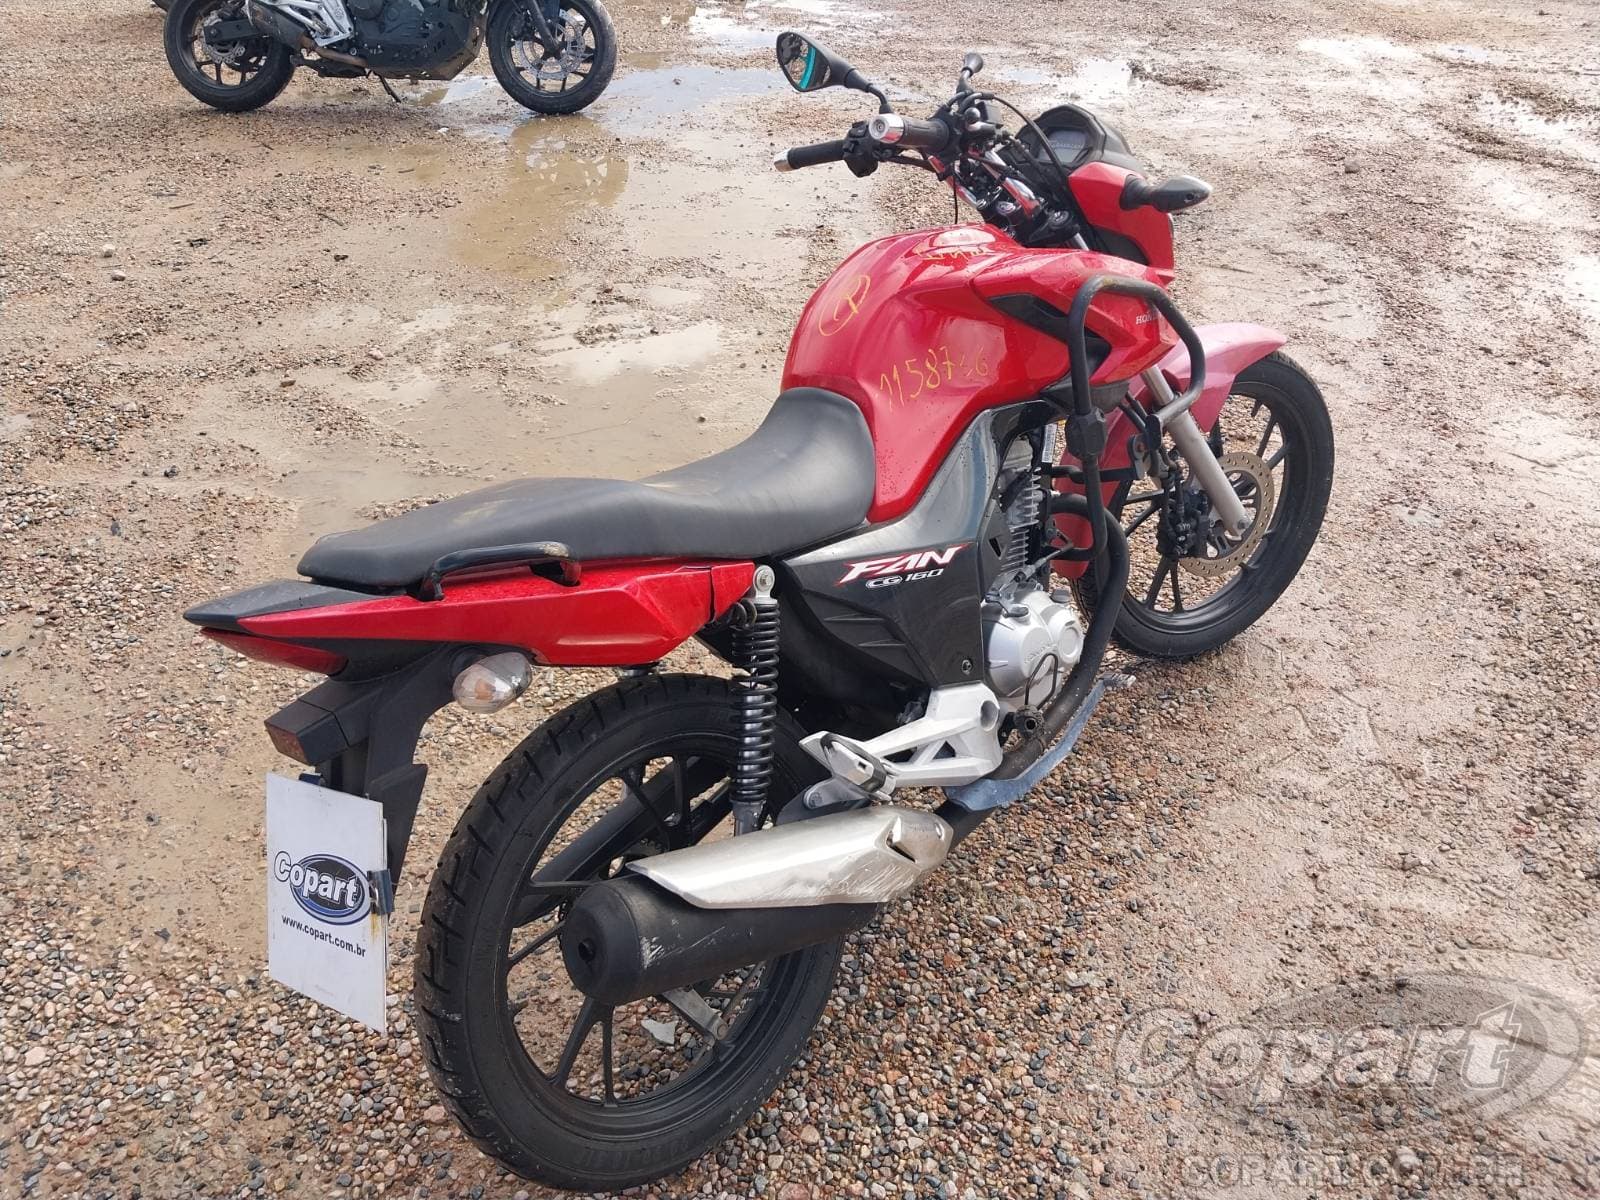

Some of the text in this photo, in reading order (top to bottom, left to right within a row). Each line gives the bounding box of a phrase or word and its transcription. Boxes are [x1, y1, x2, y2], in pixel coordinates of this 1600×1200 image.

[838, 545, 965, 585] FAN
[865, 568, 944, 589] CG 160
[274, 851, 359, 907] Copart
[282, 915, 366, 957] www.copart.com.br
